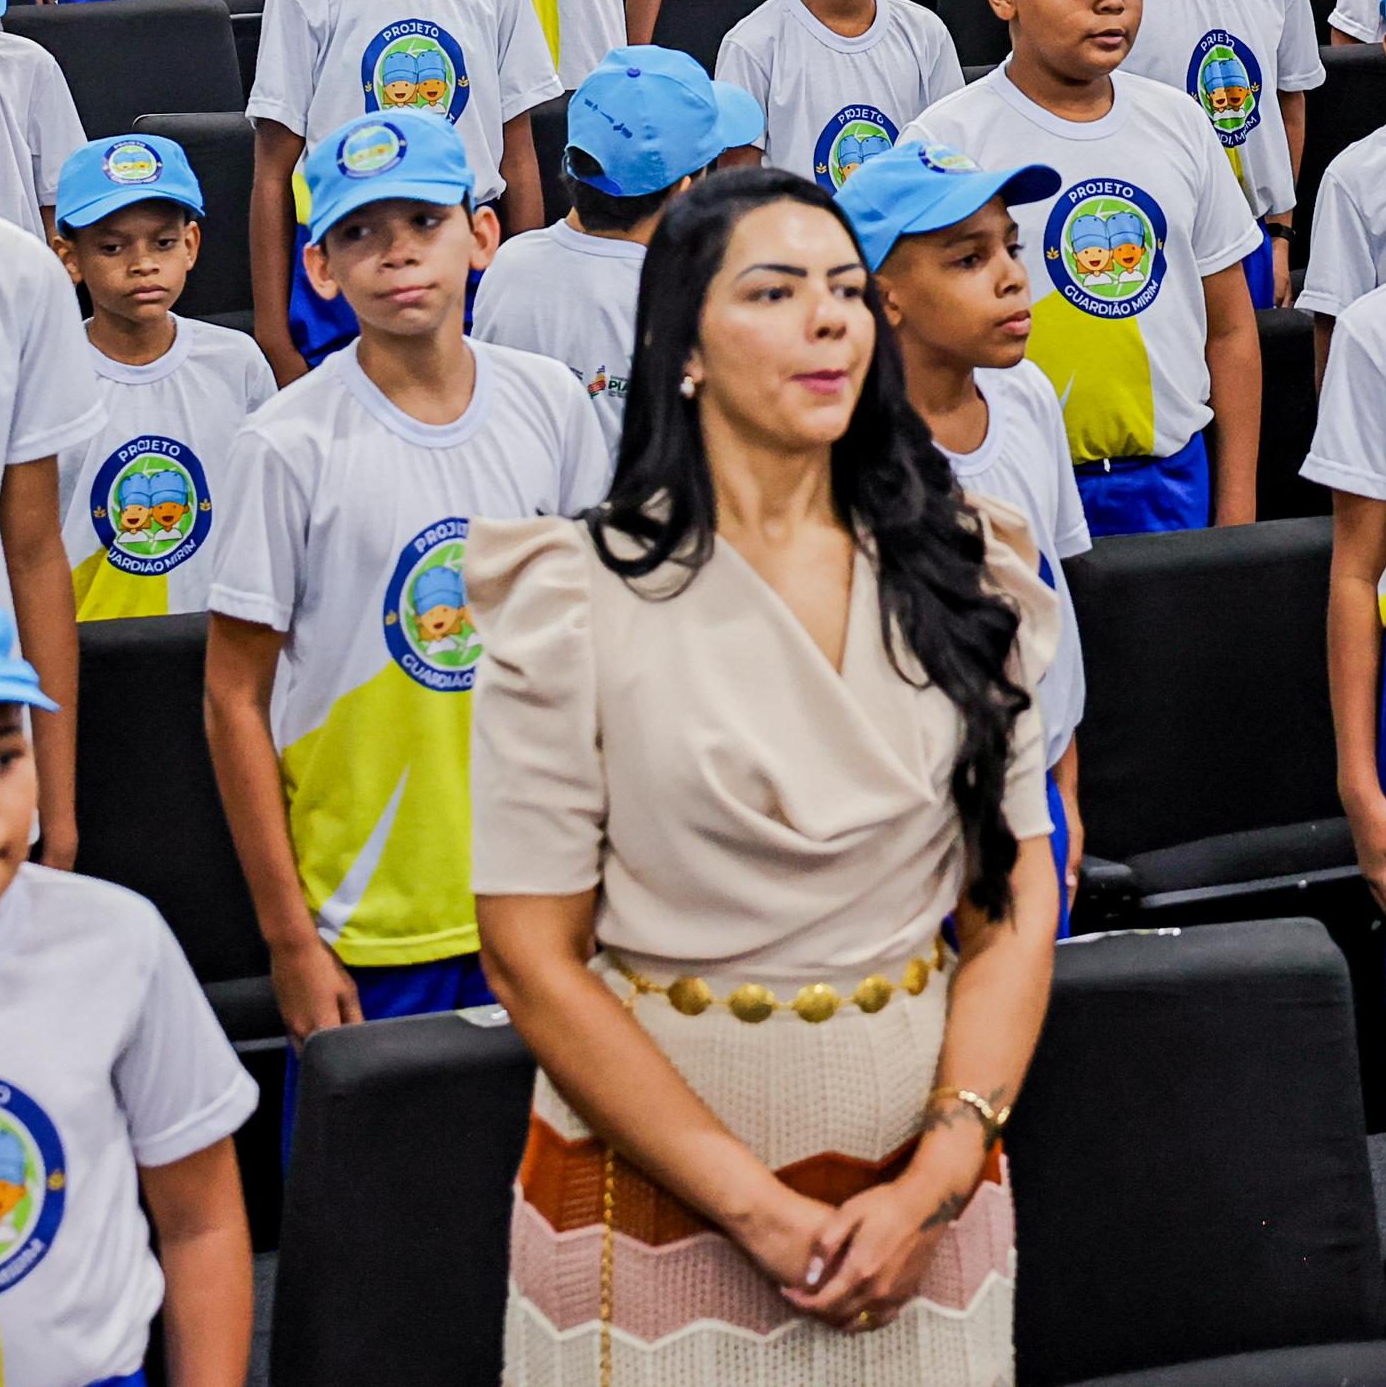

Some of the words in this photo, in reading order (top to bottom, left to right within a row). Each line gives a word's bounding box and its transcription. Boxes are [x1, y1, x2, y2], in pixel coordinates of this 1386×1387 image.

[382, 22, 439, 42] PROJETO
[1067, 181, 1134, 203] PROJETO
[1063, 284, 1132, 315] GUARDIÃO
[1131, 279, 1159, 309] MIRIM
[118, 439, 181, 461] PROJETO
[163, 539, 198, 569] MIRIM
